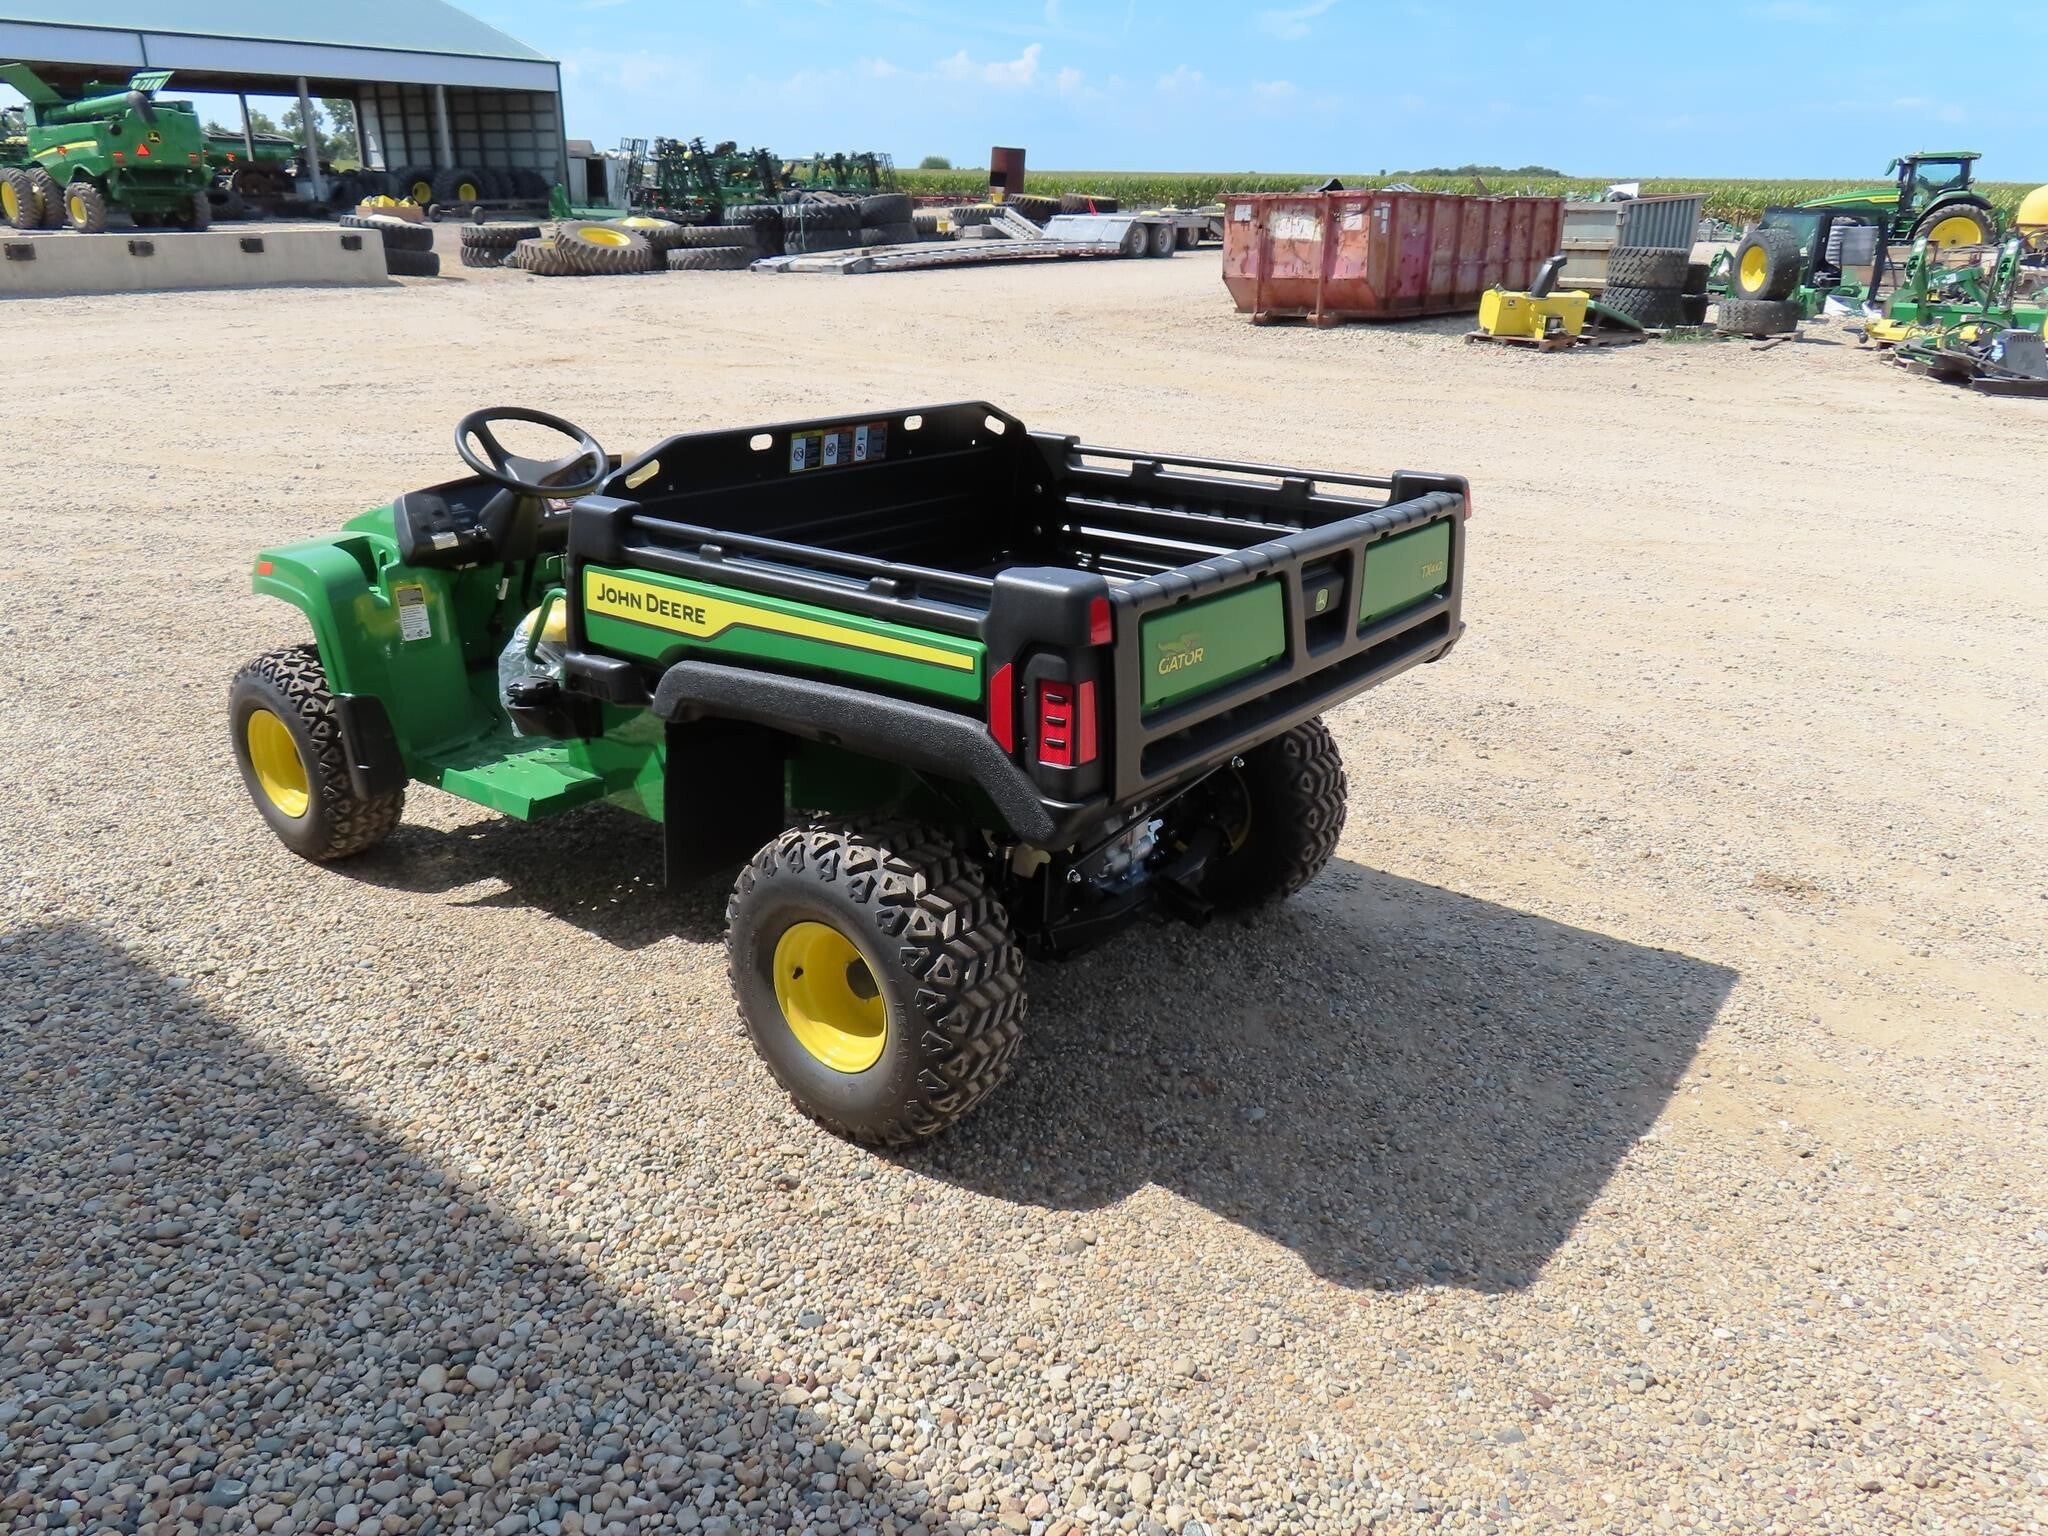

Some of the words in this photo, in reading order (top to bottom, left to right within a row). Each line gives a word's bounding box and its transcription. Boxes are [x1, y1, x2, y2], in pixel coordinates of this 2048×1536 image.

[597, 583, 642, 610] JOHN
[646, 593, 706, 625] DEERE
[1158, 647, 1205, 675] GATOR
